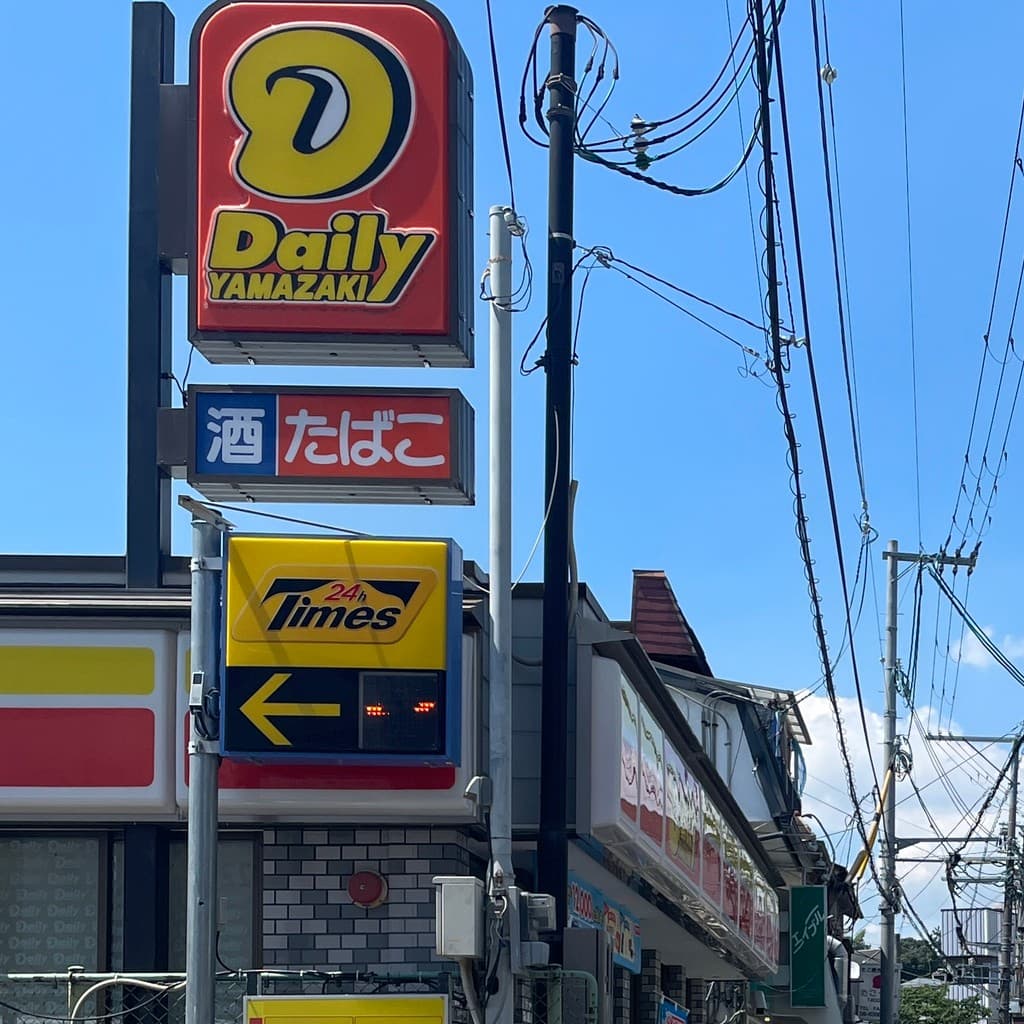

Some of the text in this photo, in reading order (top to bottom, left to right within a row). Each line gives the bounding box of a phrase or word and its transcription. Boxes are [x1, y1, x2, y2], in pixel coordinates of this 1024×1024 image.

[207, 211, 434, 304] Daily
[208, 272, 368, 301] YAMAZAKI
[206, 406, 266, 465] 酒
[284, 408, 446, 467] たばこ
[267, 594, 402, 631] Times
[325, 583, 367, 602] 24h
[791, 904, 828, 955] エイブル
